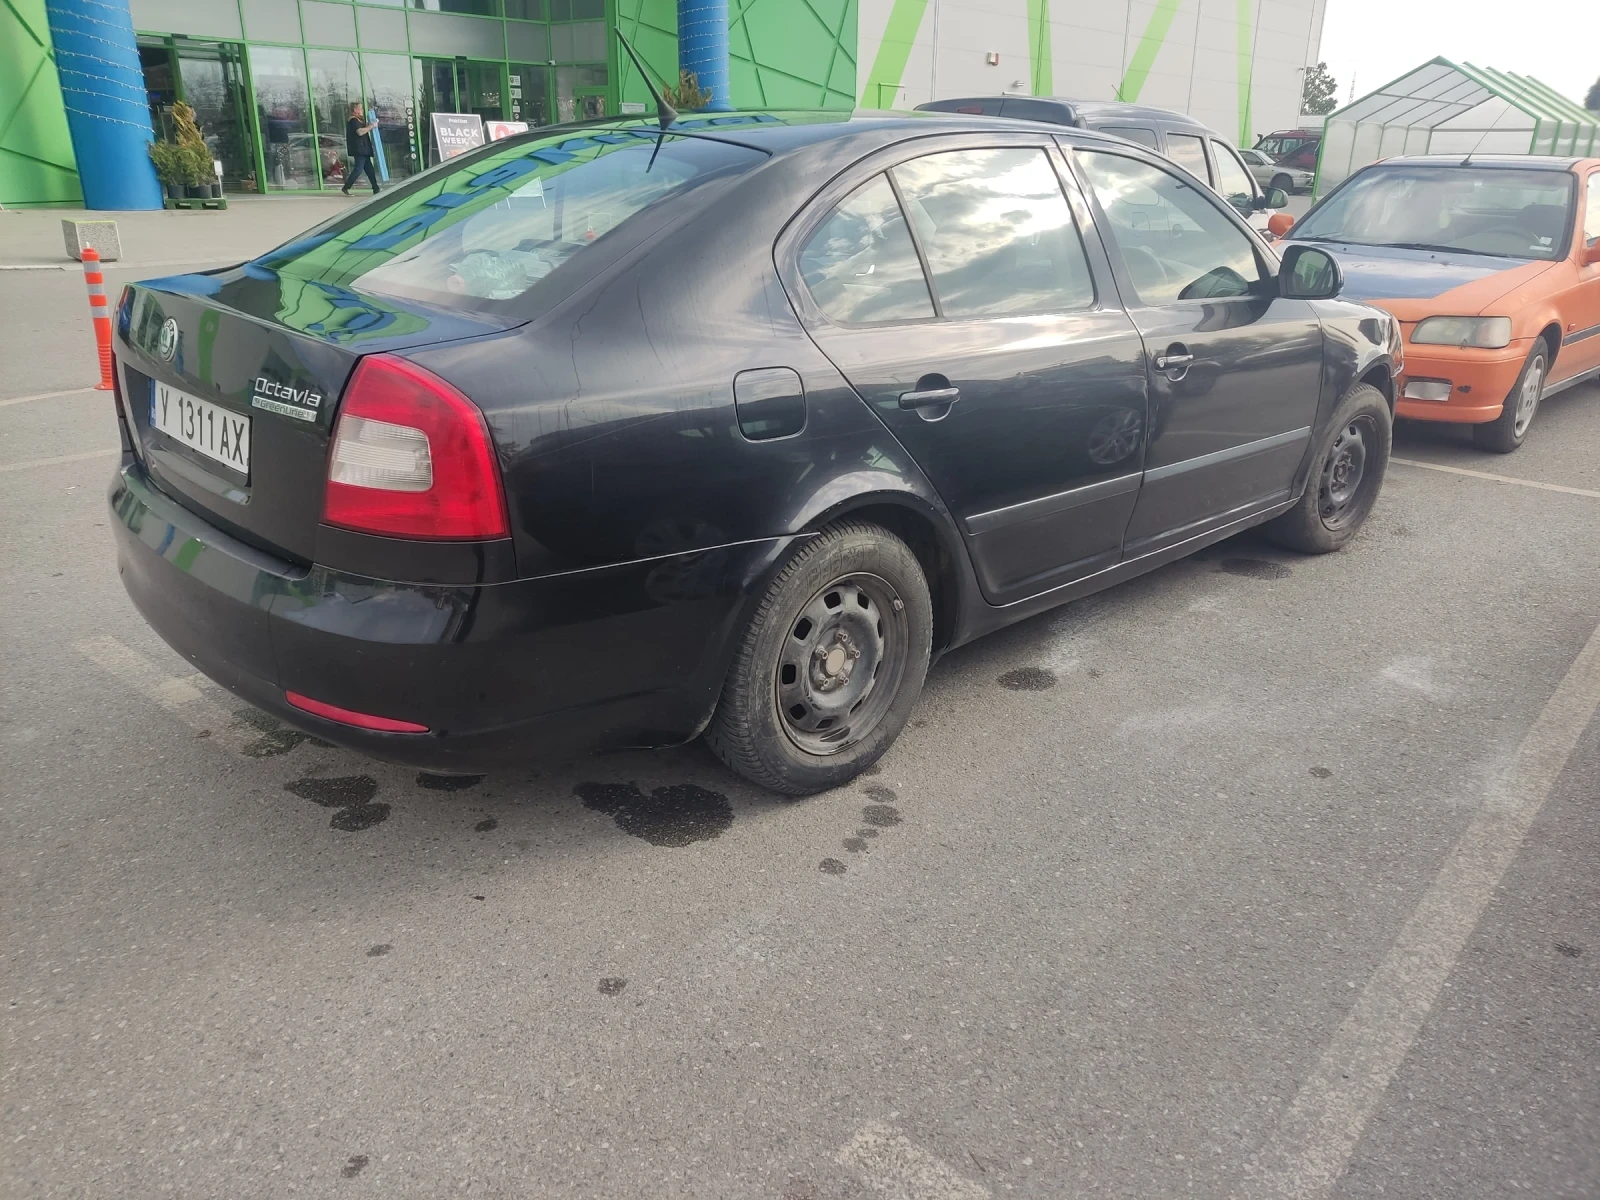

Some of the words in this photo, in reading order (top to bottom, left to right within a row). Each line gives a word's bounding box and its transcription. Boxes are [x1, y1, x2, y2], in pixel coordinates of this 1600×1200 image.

[440, 127, 479, 138] BLACK
[441, 136, 467, 144] WEEK
[254, 377, 322, 408] Octavia
